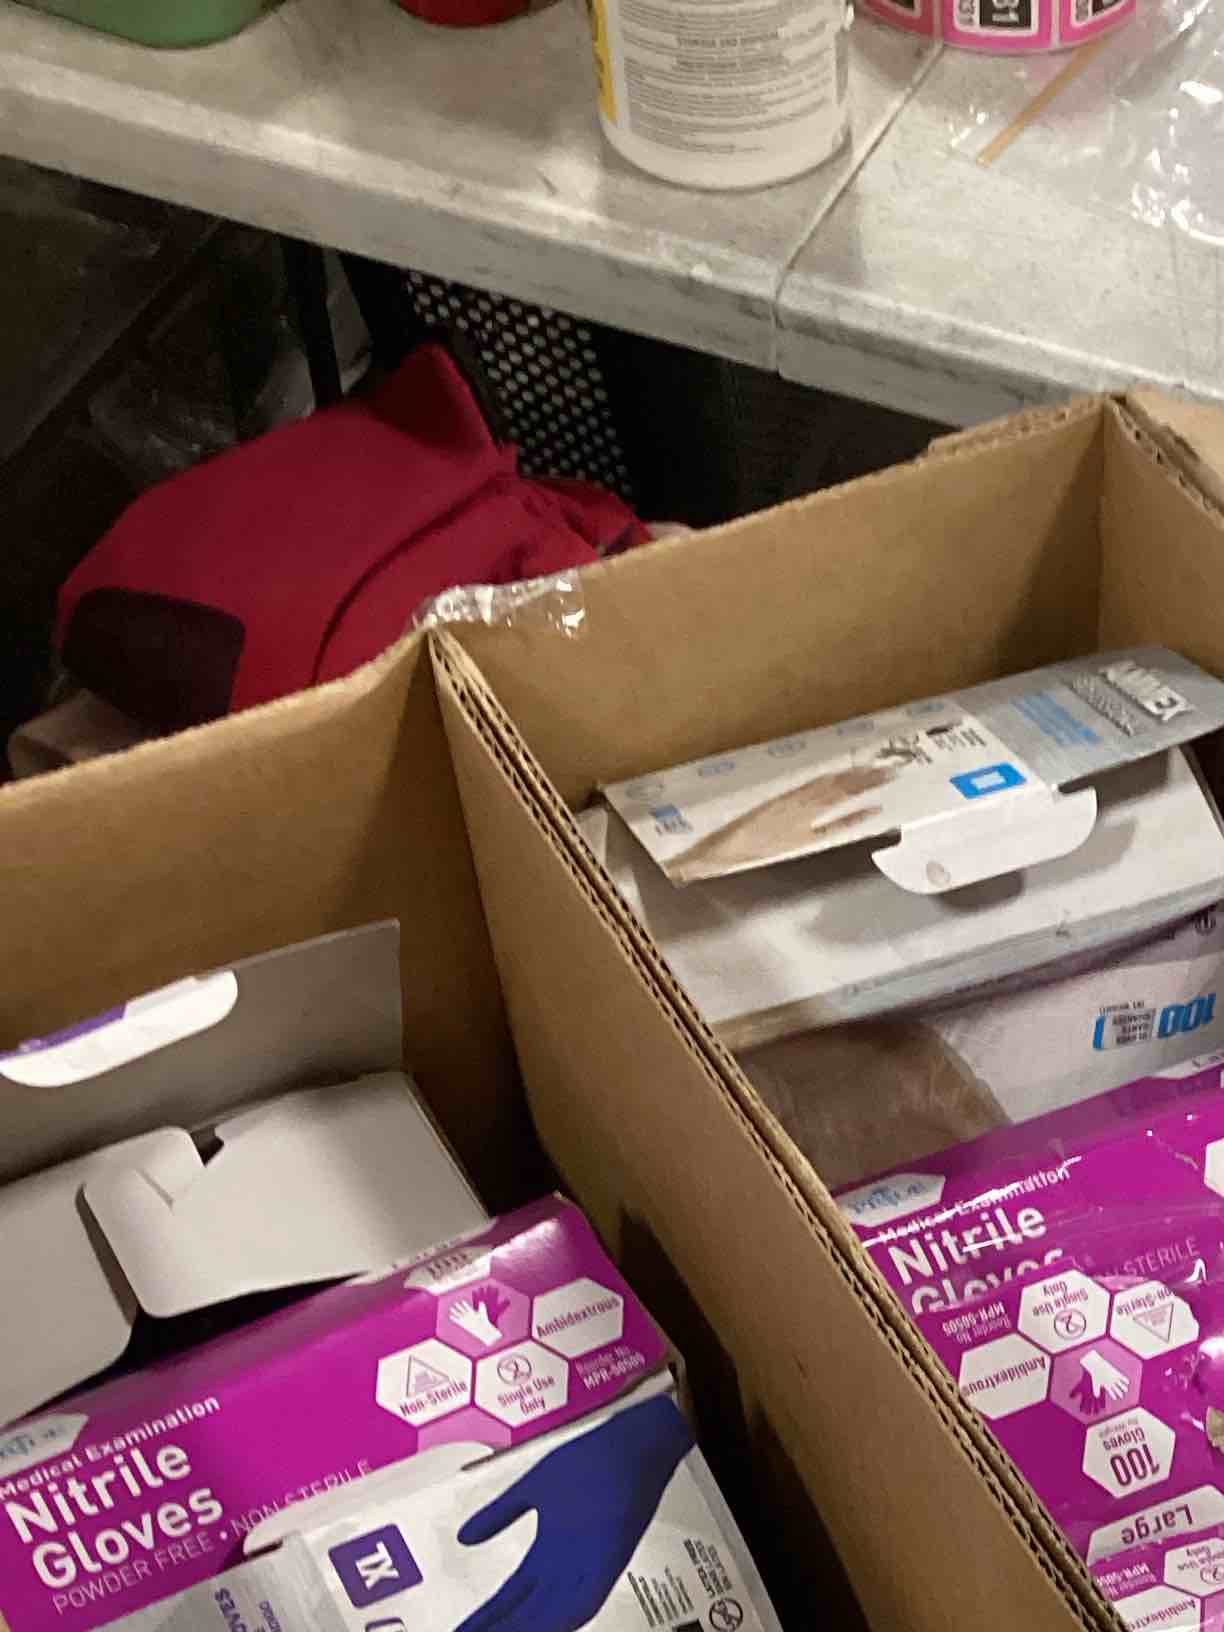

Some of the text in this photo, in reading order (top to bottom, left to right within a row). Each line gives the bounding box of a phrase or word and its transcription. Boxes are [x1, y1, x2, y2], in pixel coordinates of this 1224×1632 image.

[888, 1206, 1047, 1286] Nitrile
[537, 1297, 622, 1338] Ambidextrous
[400, 1380, 469, 1418] Non-Sterile
[0, 1454, 83, 1498] Medical
[85, 1395, 222, 1461] Examination
[1102, 1427, 1146, 1451] Gloves
[1110, 1443, 1161, 1487] 100
[5, 1444, 192, 1544] Nitrile
[31, 1487, 225, 1589] Gloves
[1121, 1504, 1194, 1546] Large
[50, 1559, 154, 1615] POWDER
[153, 1530, 215, 1573] FREE
[355, 1541, 400, 1591] XL
